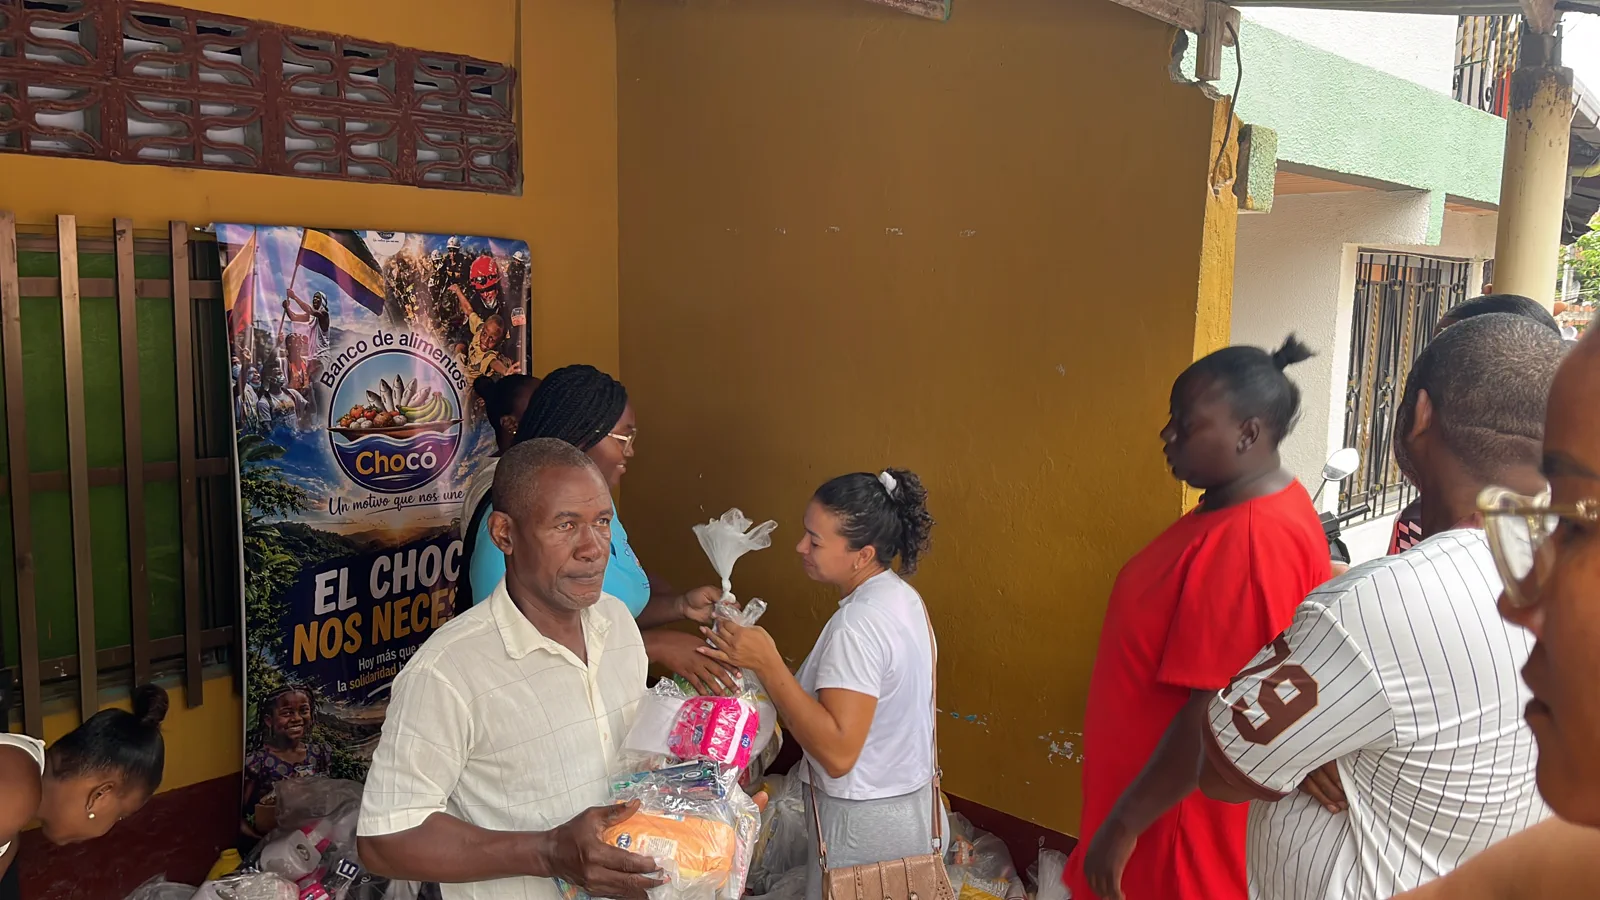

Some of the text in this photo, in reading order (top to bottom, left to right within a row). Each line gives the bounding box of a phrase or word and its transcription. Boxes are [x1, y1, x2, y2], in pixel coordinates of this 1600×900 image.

[320, 330, 467, 391] Banco de alimentos
[356, 446, 436, 475] Chocó
[329, 489, 465, 516] Un motivo que nos une
[313, 540, 464, 616] EL CHOC
[292, 611, 363, 666] NOS
[358, 656, 375, 673] Hoy
[376, 648, 397, 666] más
[399, 645, 417, 660] que
[336, 679, 347, 692] la
[349, 665, 397, 690] solidaridad
